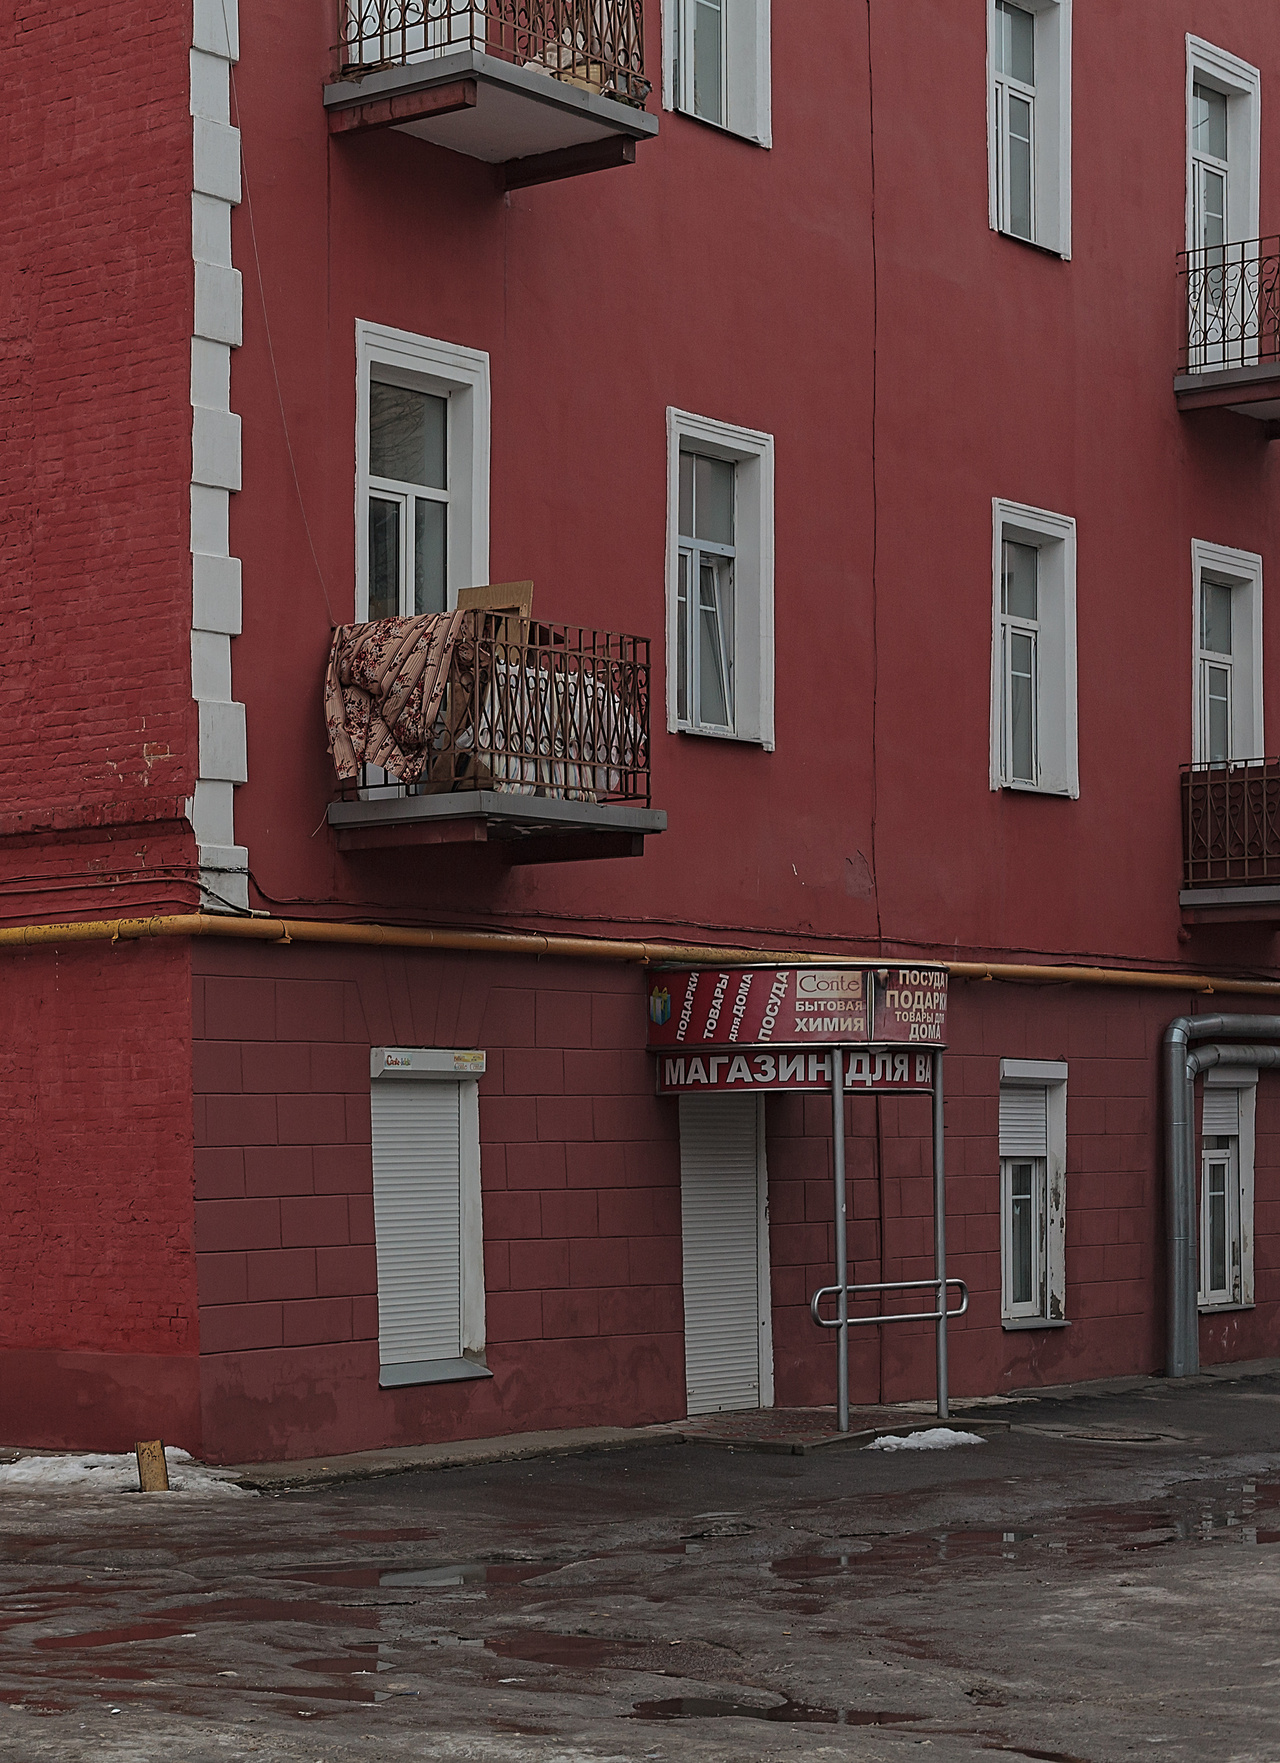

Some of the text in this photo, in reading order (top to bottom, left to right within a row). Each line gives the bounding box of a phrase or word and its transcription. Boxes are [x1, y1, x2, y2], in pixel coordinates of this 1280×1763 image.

[799, 974, 860, 993] Conte
[898, 970, 945, 990] ПОСУДА
[732, 973, 754, 1017] ДОМА
[676, 971, 700, 1041] ПОДАРКИ
[703, 973, 730, 1039] ТОВАРЫ
[757, 971, 790, 1041] ПОСУДА
[795, 1000, 863, 1012] БЫТОВАЯ
[794, 1017, 865, 1032] ХИМИЯ
[894, 1011, 934, 1023] ТОВАРЫ
[908, 1023, 941, 1041] ДОМА
[664, 1054, 832, 1086] МАГАЗИН
[845, 1053, 909, 1086] ДЛЯ
